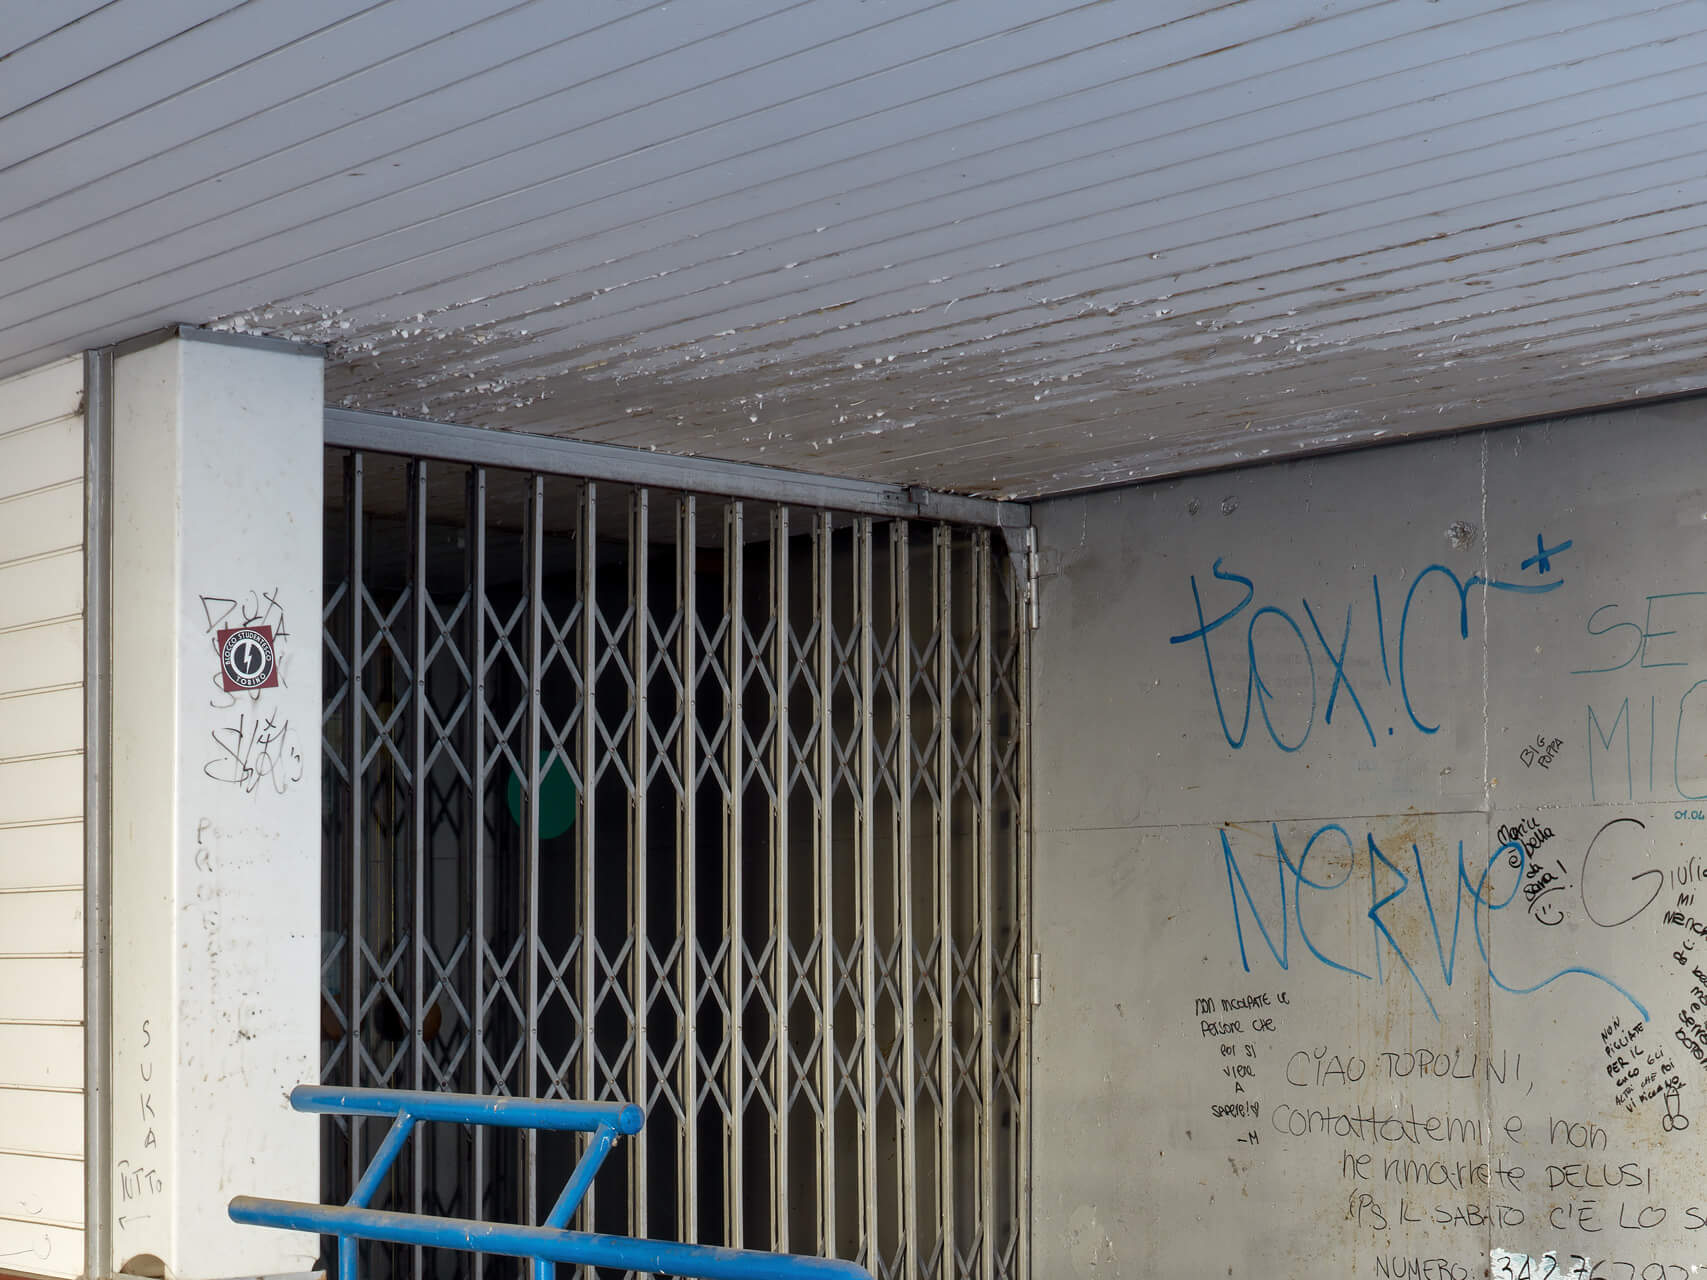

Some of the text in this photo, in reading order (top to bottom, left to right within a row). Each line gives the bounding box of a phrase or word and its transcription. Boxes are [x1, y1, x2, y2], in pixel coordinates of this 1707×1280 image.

[224, 631, 272, 665] BLOCCO STUDENTESCO
[236, 673, 266, 685] TORINO
[1520, 734, 1546, 768] BIG
[1537, 737, 1564, 769] POPPA
[1677, 892, 1695, 907] MI
[1601, 1015, 1621, 1044] NON
[1245, 1043, 1257, 1059] SI
[1606, 1056, 1630, 1079] PER
[1641, 1072, 1657, 1089] CHE
[1235, 1081, 1245, 1093] A
[1503, 1115, 1523, 1144] e
[1550, 1116, 1608, 1151] non
[1545, 1162, 1651, 1195] DELUSI
[1400, 1198, 1422, 1226] IL
[1435, 1203, 1525, 1230] SABATO
[1619, 1202, 1668, 1230] LO
